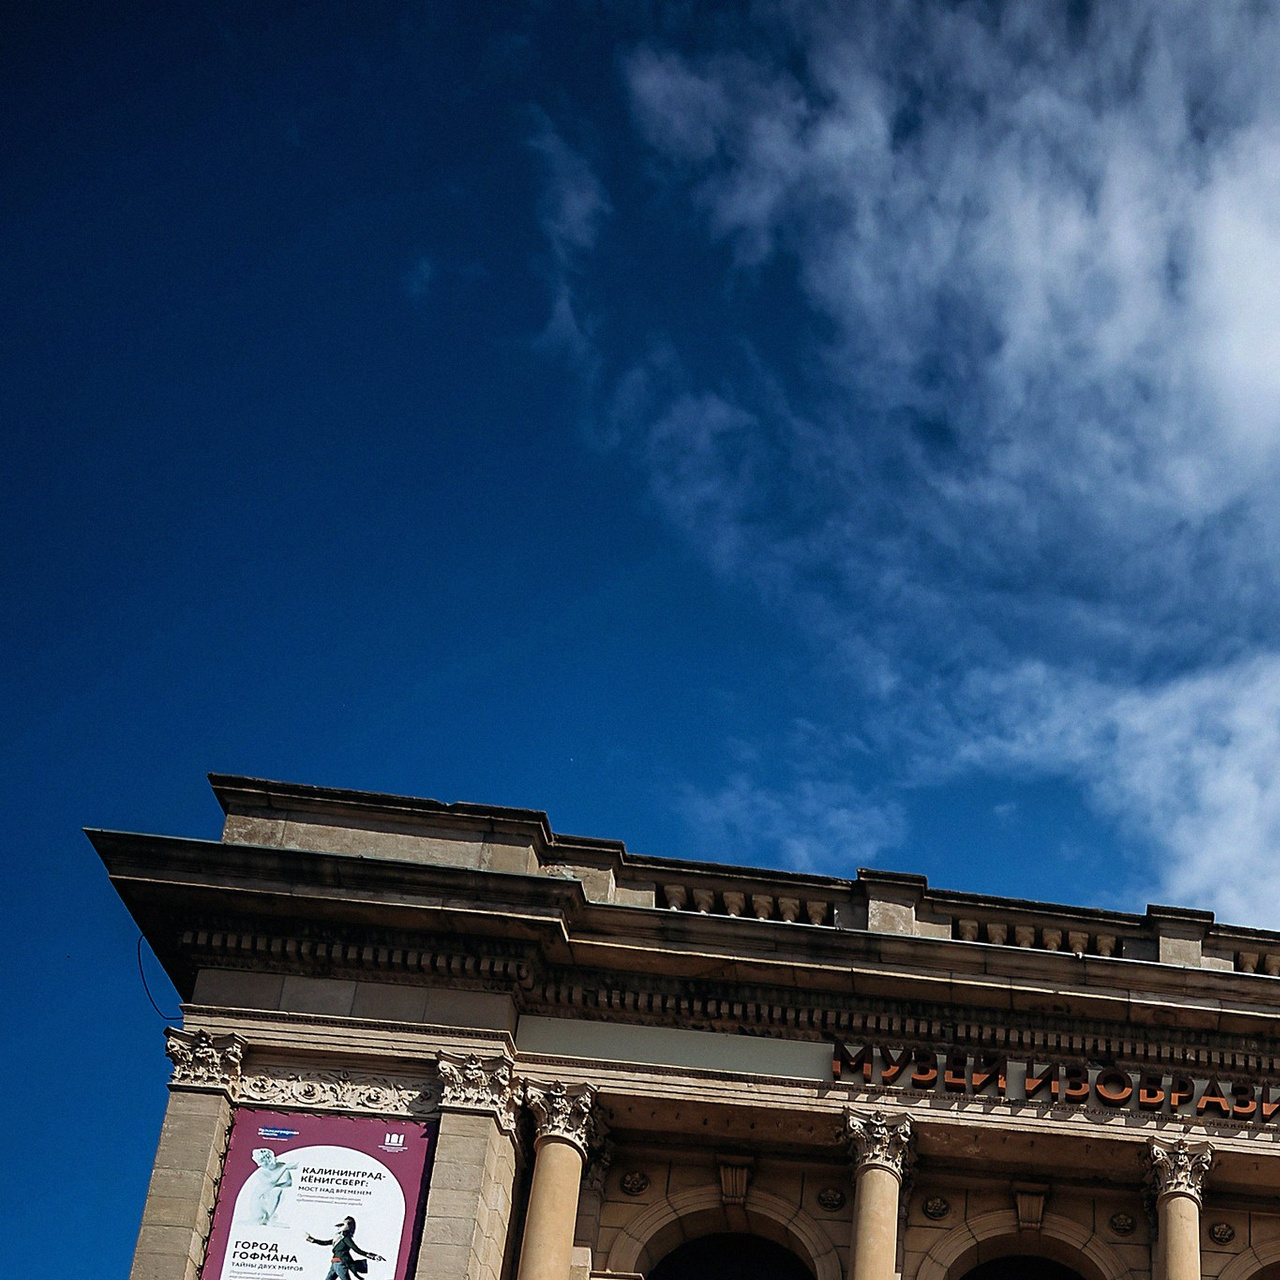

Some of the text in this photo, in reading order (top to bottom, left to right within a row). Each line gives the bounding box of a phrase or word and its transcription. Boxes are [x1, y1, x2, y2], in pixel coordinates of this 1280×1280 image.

[302, 1167, 387, 1181] КАЛИНИНГРАД-
[300, 1175, 369, 1187] КЁНИГСБЕРГ:
[336, 1188, 372, 1196] ВРЕМЕНЕМ
[234, 1240, 279, 1253] ГОРОД
[232, 1251, 298, 1263] ГОФМАНА
